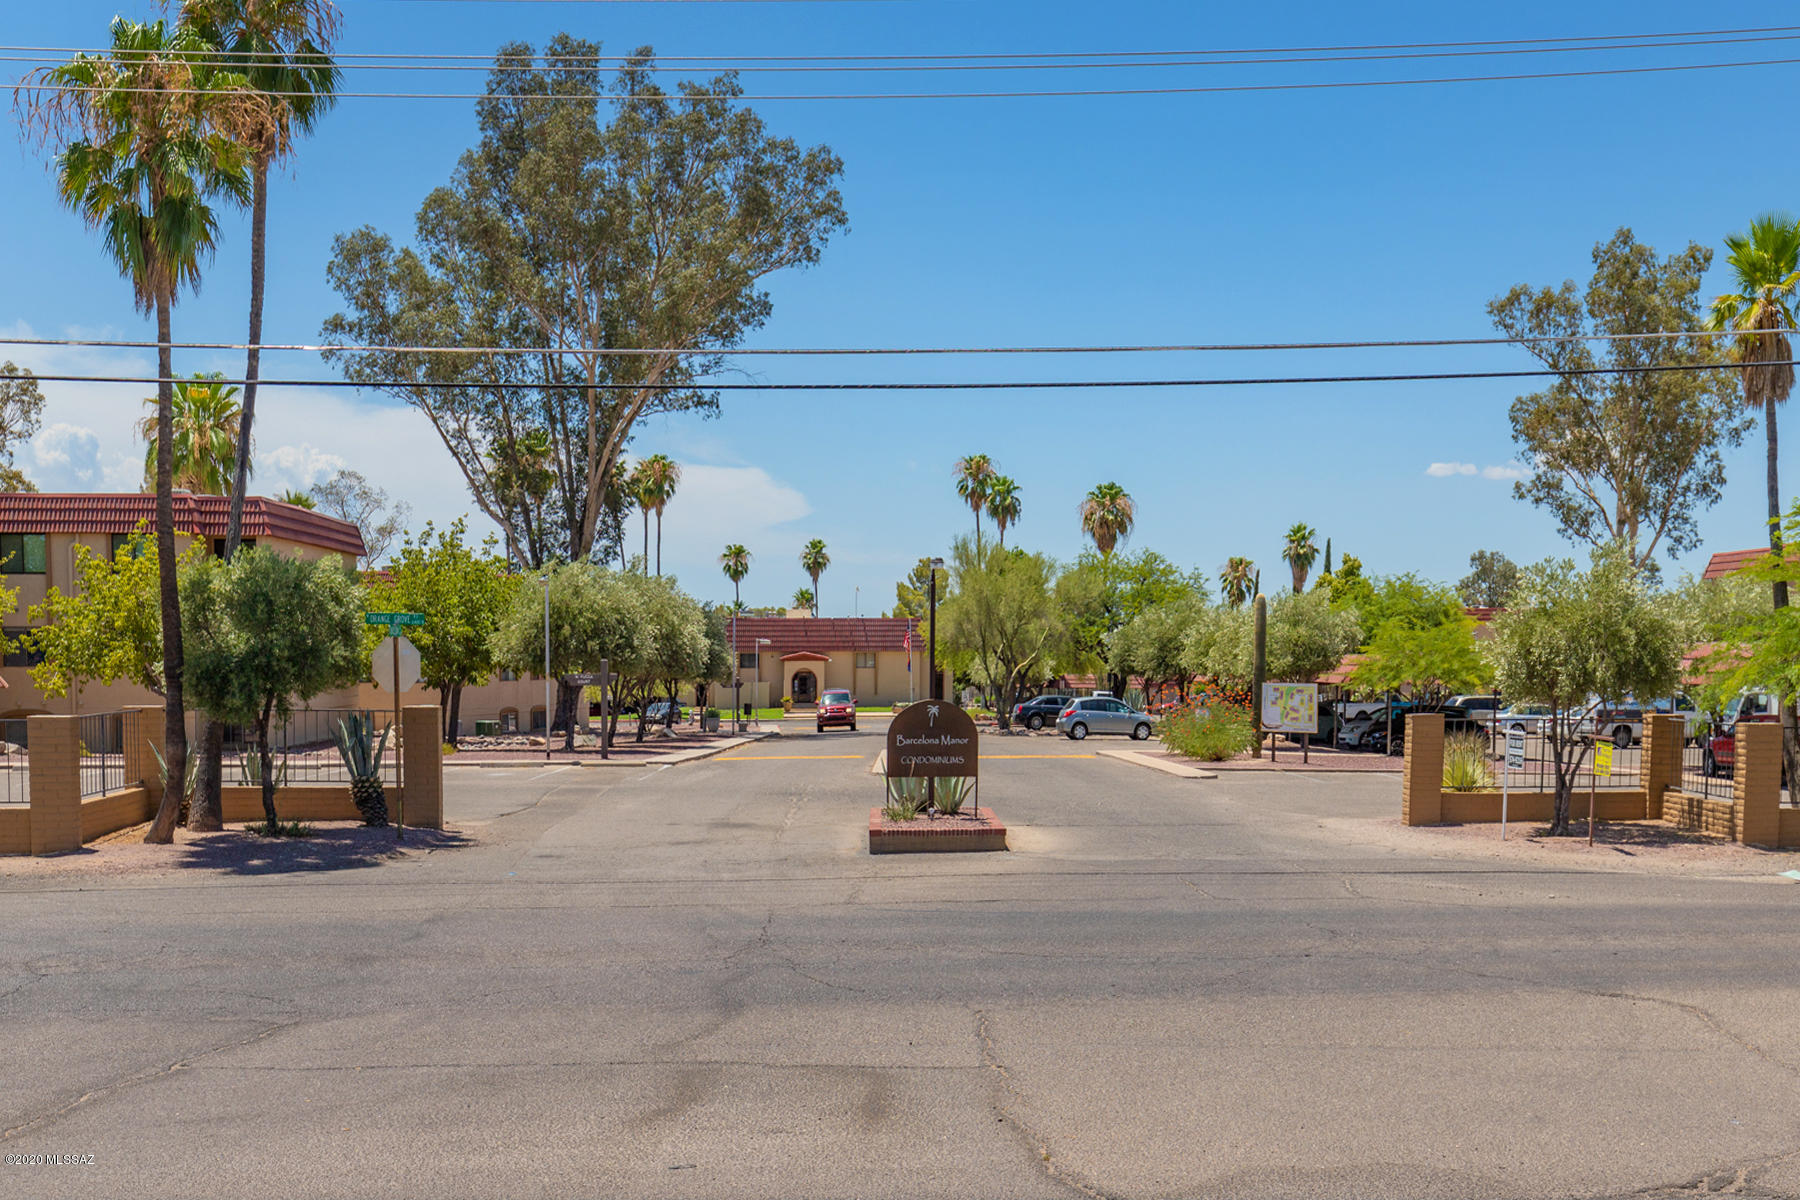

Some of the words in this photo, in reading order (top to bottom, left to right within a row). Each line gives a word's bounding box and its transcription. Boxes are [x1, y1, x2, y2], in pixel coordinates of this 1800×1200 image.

[370, 614, 391, 623] ORANGE
[394, 614, 410, 623] GROVE
[896, 734, 940, 746] Barcelona
[941, 735, 969, 746] Manor
[900, 755, 965, 765] CONDOMINIUMS
